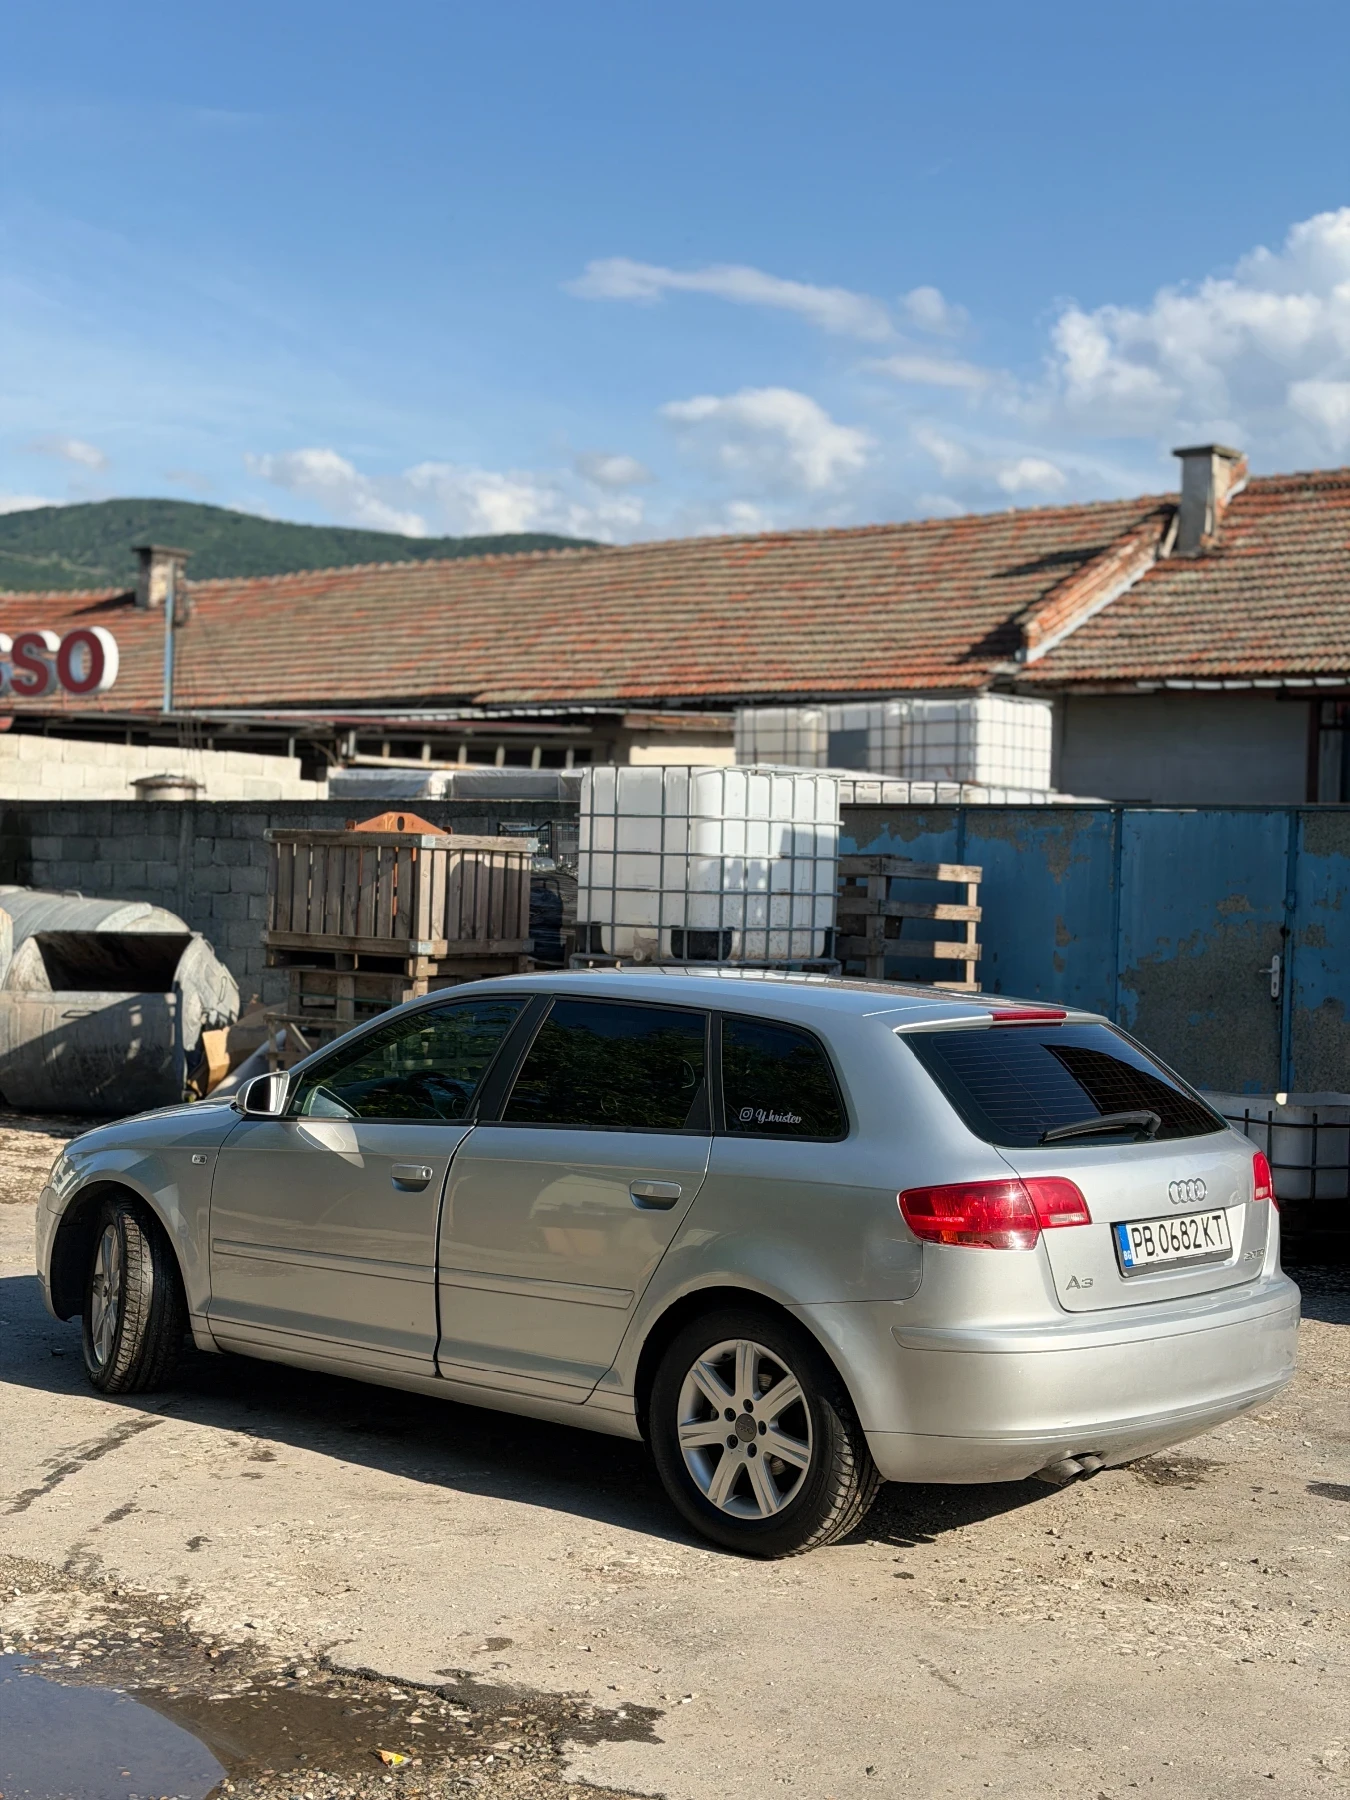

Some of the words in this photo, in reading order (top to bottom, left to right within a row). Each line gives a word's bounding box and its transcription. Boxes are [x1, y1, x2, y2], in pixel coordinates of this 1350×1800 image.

[0, 626, 119, 696] SO
[1123, 1250, 1132, 1260] BG
[1065, 1274, 1093, 1291] A3
